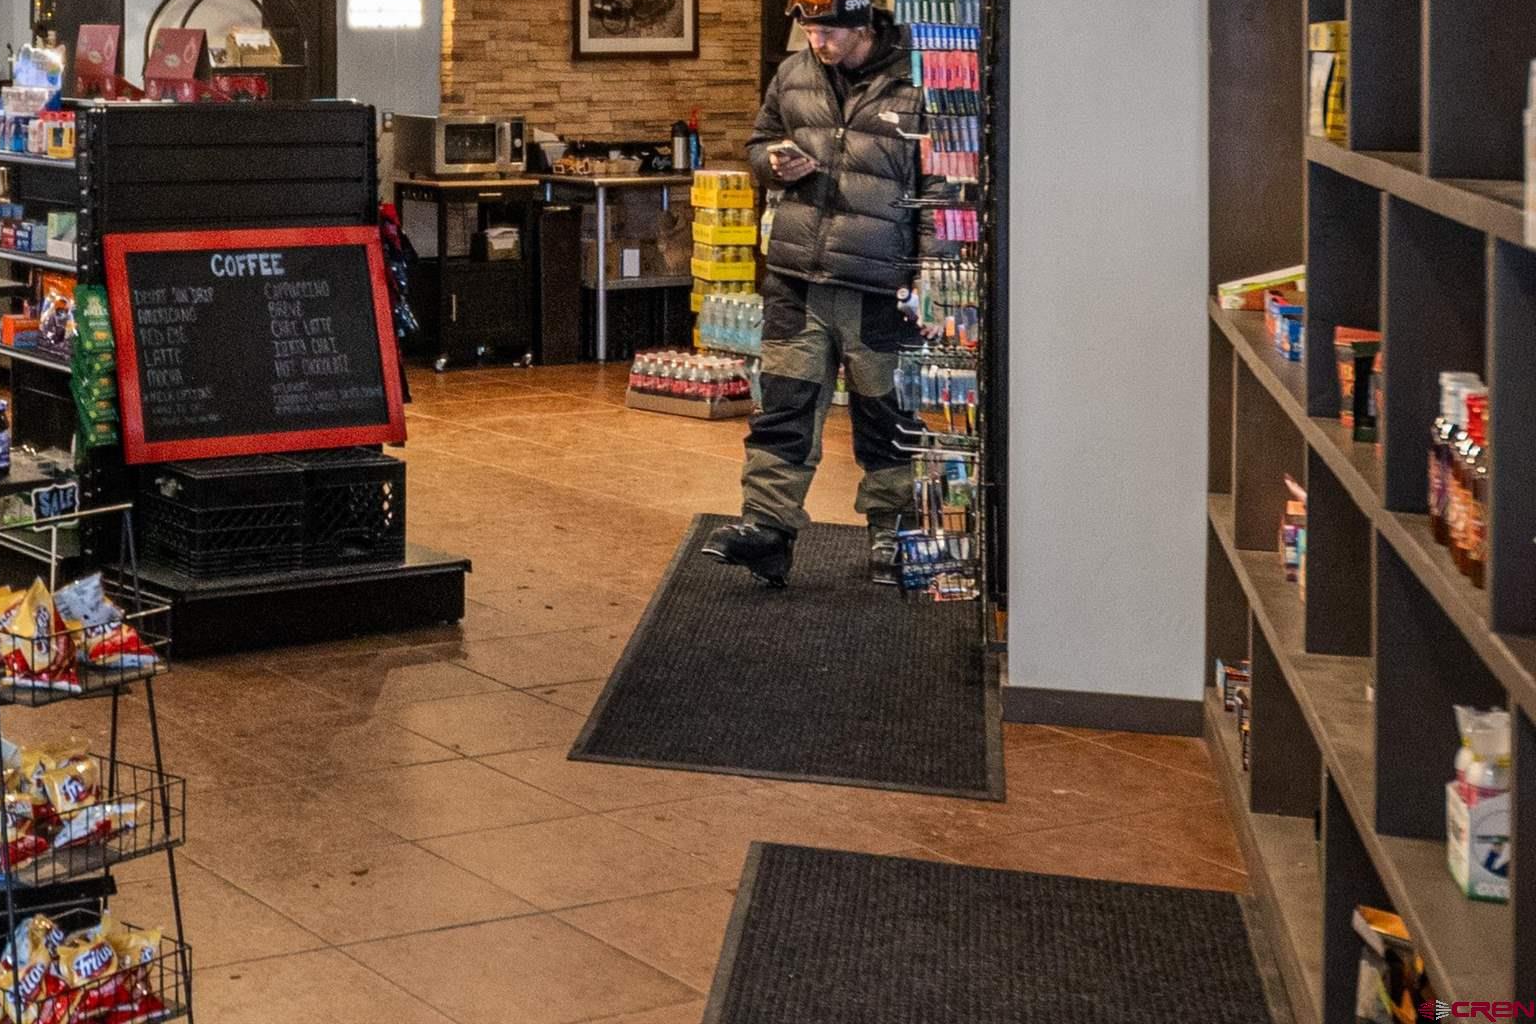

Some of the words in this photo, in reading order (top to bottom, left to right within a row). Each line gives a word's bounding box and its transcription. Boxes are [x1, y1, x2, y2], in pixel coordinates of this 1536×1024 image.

[210, 252, 285, 277] COFFEE
[144, 348, 183, 367] LATTE
[39, 487, 74, 517] SALE
